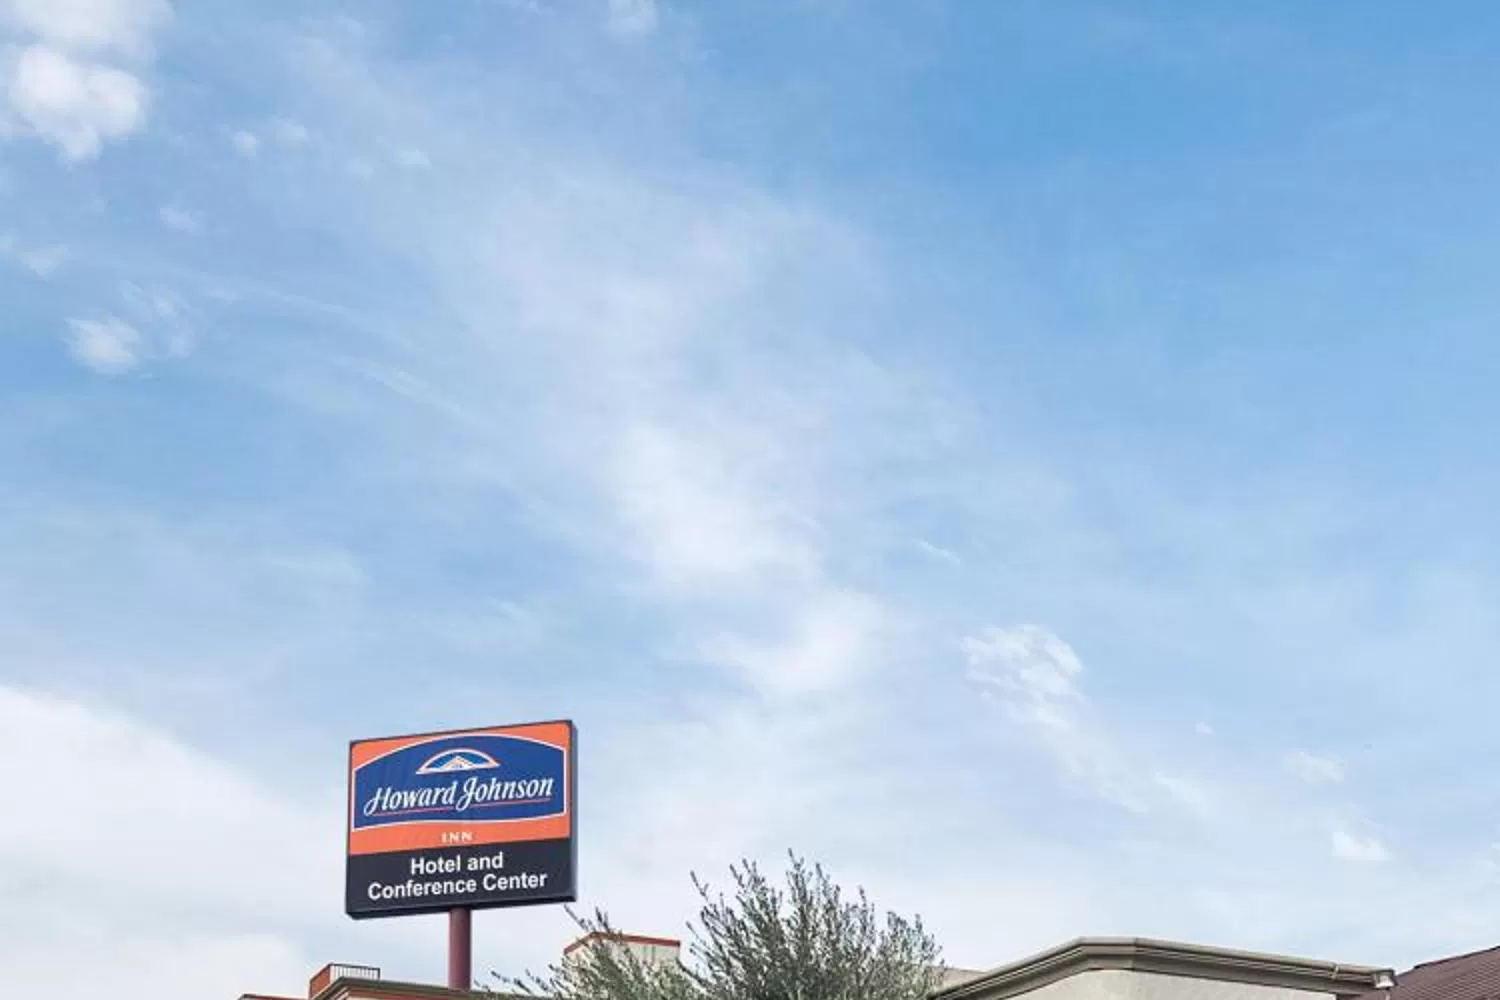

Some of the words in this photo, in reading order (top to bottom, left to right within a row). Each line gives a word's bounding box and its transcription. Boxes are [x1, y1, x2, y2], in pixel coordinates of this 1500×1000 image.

[363, 780, 458, 817] Howard
[455, 776, 554, 812] Johnson
[441, 832, 473, 843] INN
[411, 856, 461, 875] Hotel
[467, 852, 504, 871] and
[368, 878, 477, 900] Conference
[483, 873, 548, 890] Center
